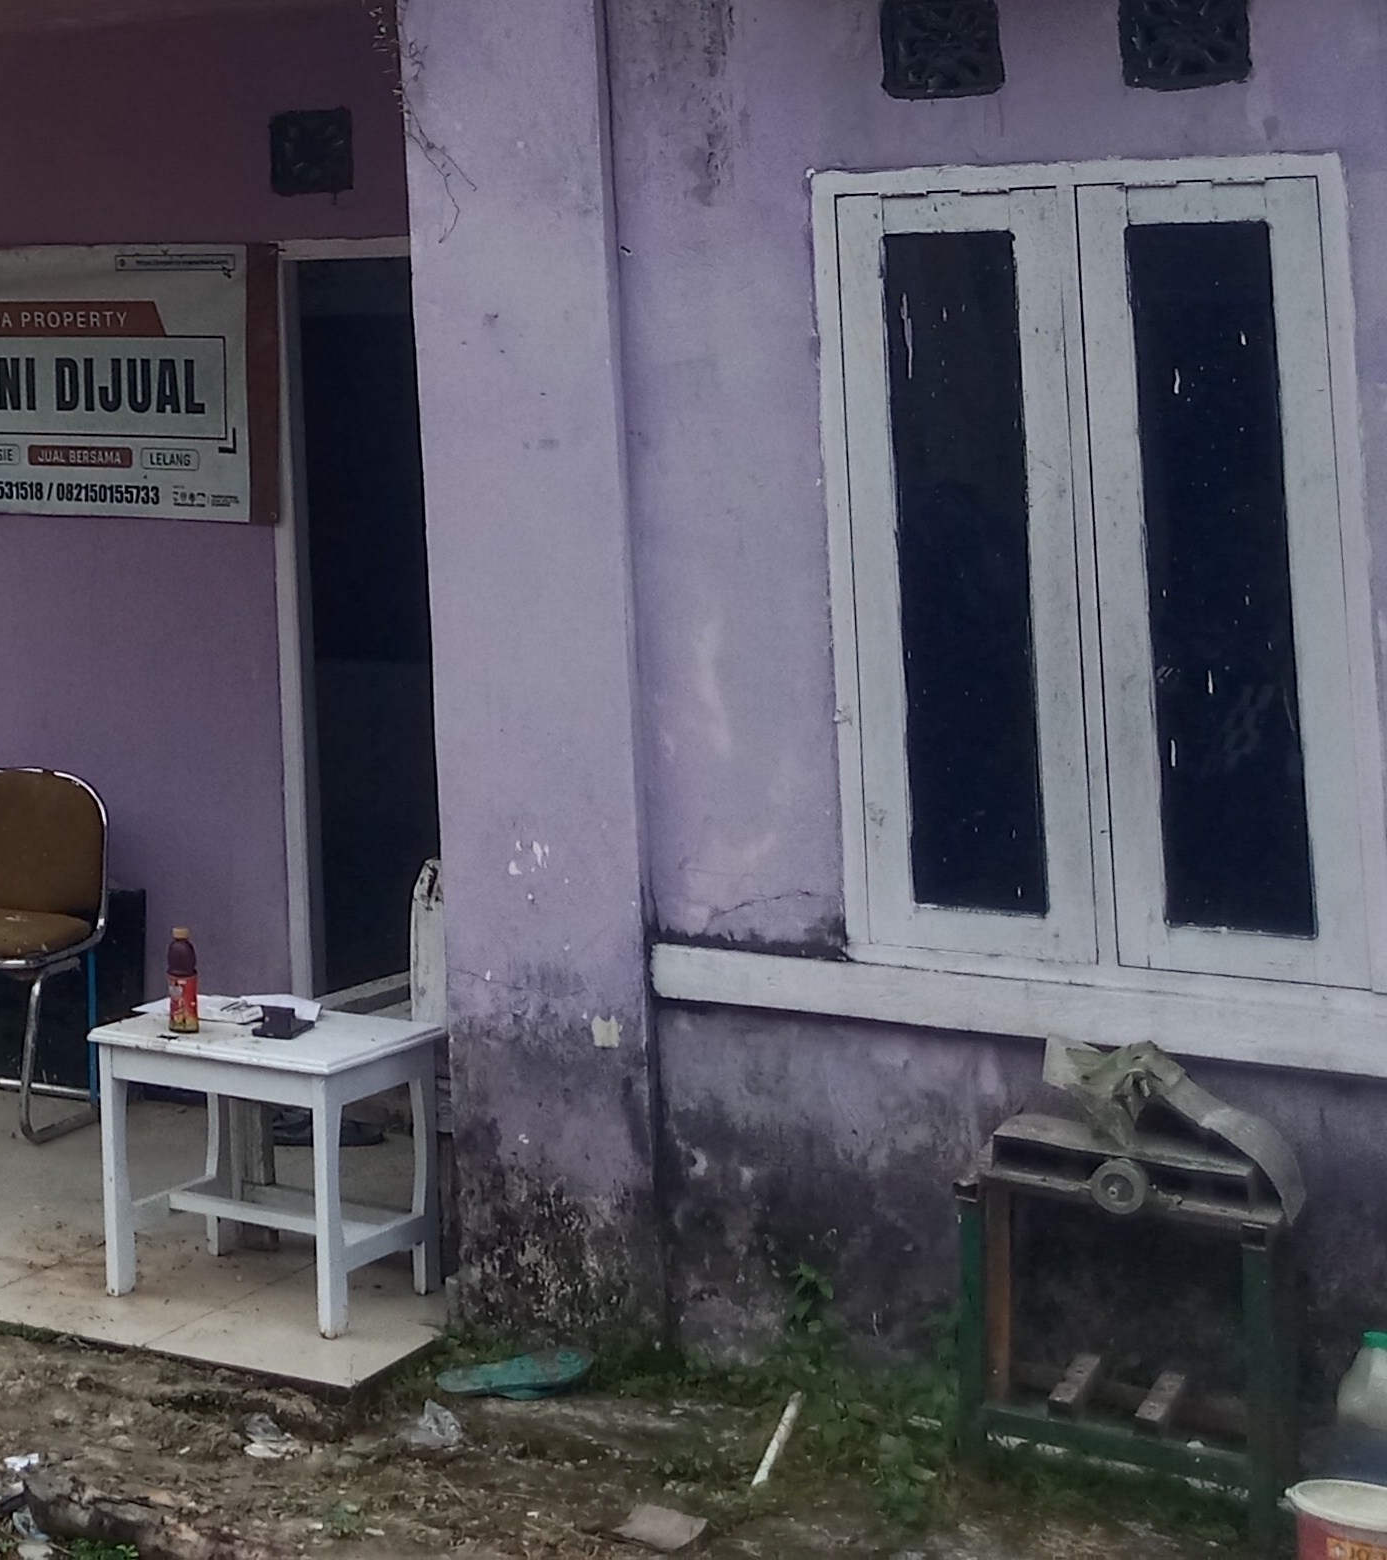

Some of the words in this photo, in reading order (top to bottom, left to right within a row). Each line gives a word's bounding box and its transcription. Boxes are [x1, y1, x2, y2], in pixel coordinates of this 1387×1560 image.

[21, 310, 128, 328] PROPERTY
[55, 358, 206, 414] DIJUAL
[38, 449, 67, 463] JUAL
[69, 450, 122, 465] BERSAMA
[149, 451, 191, 467] LELANG
